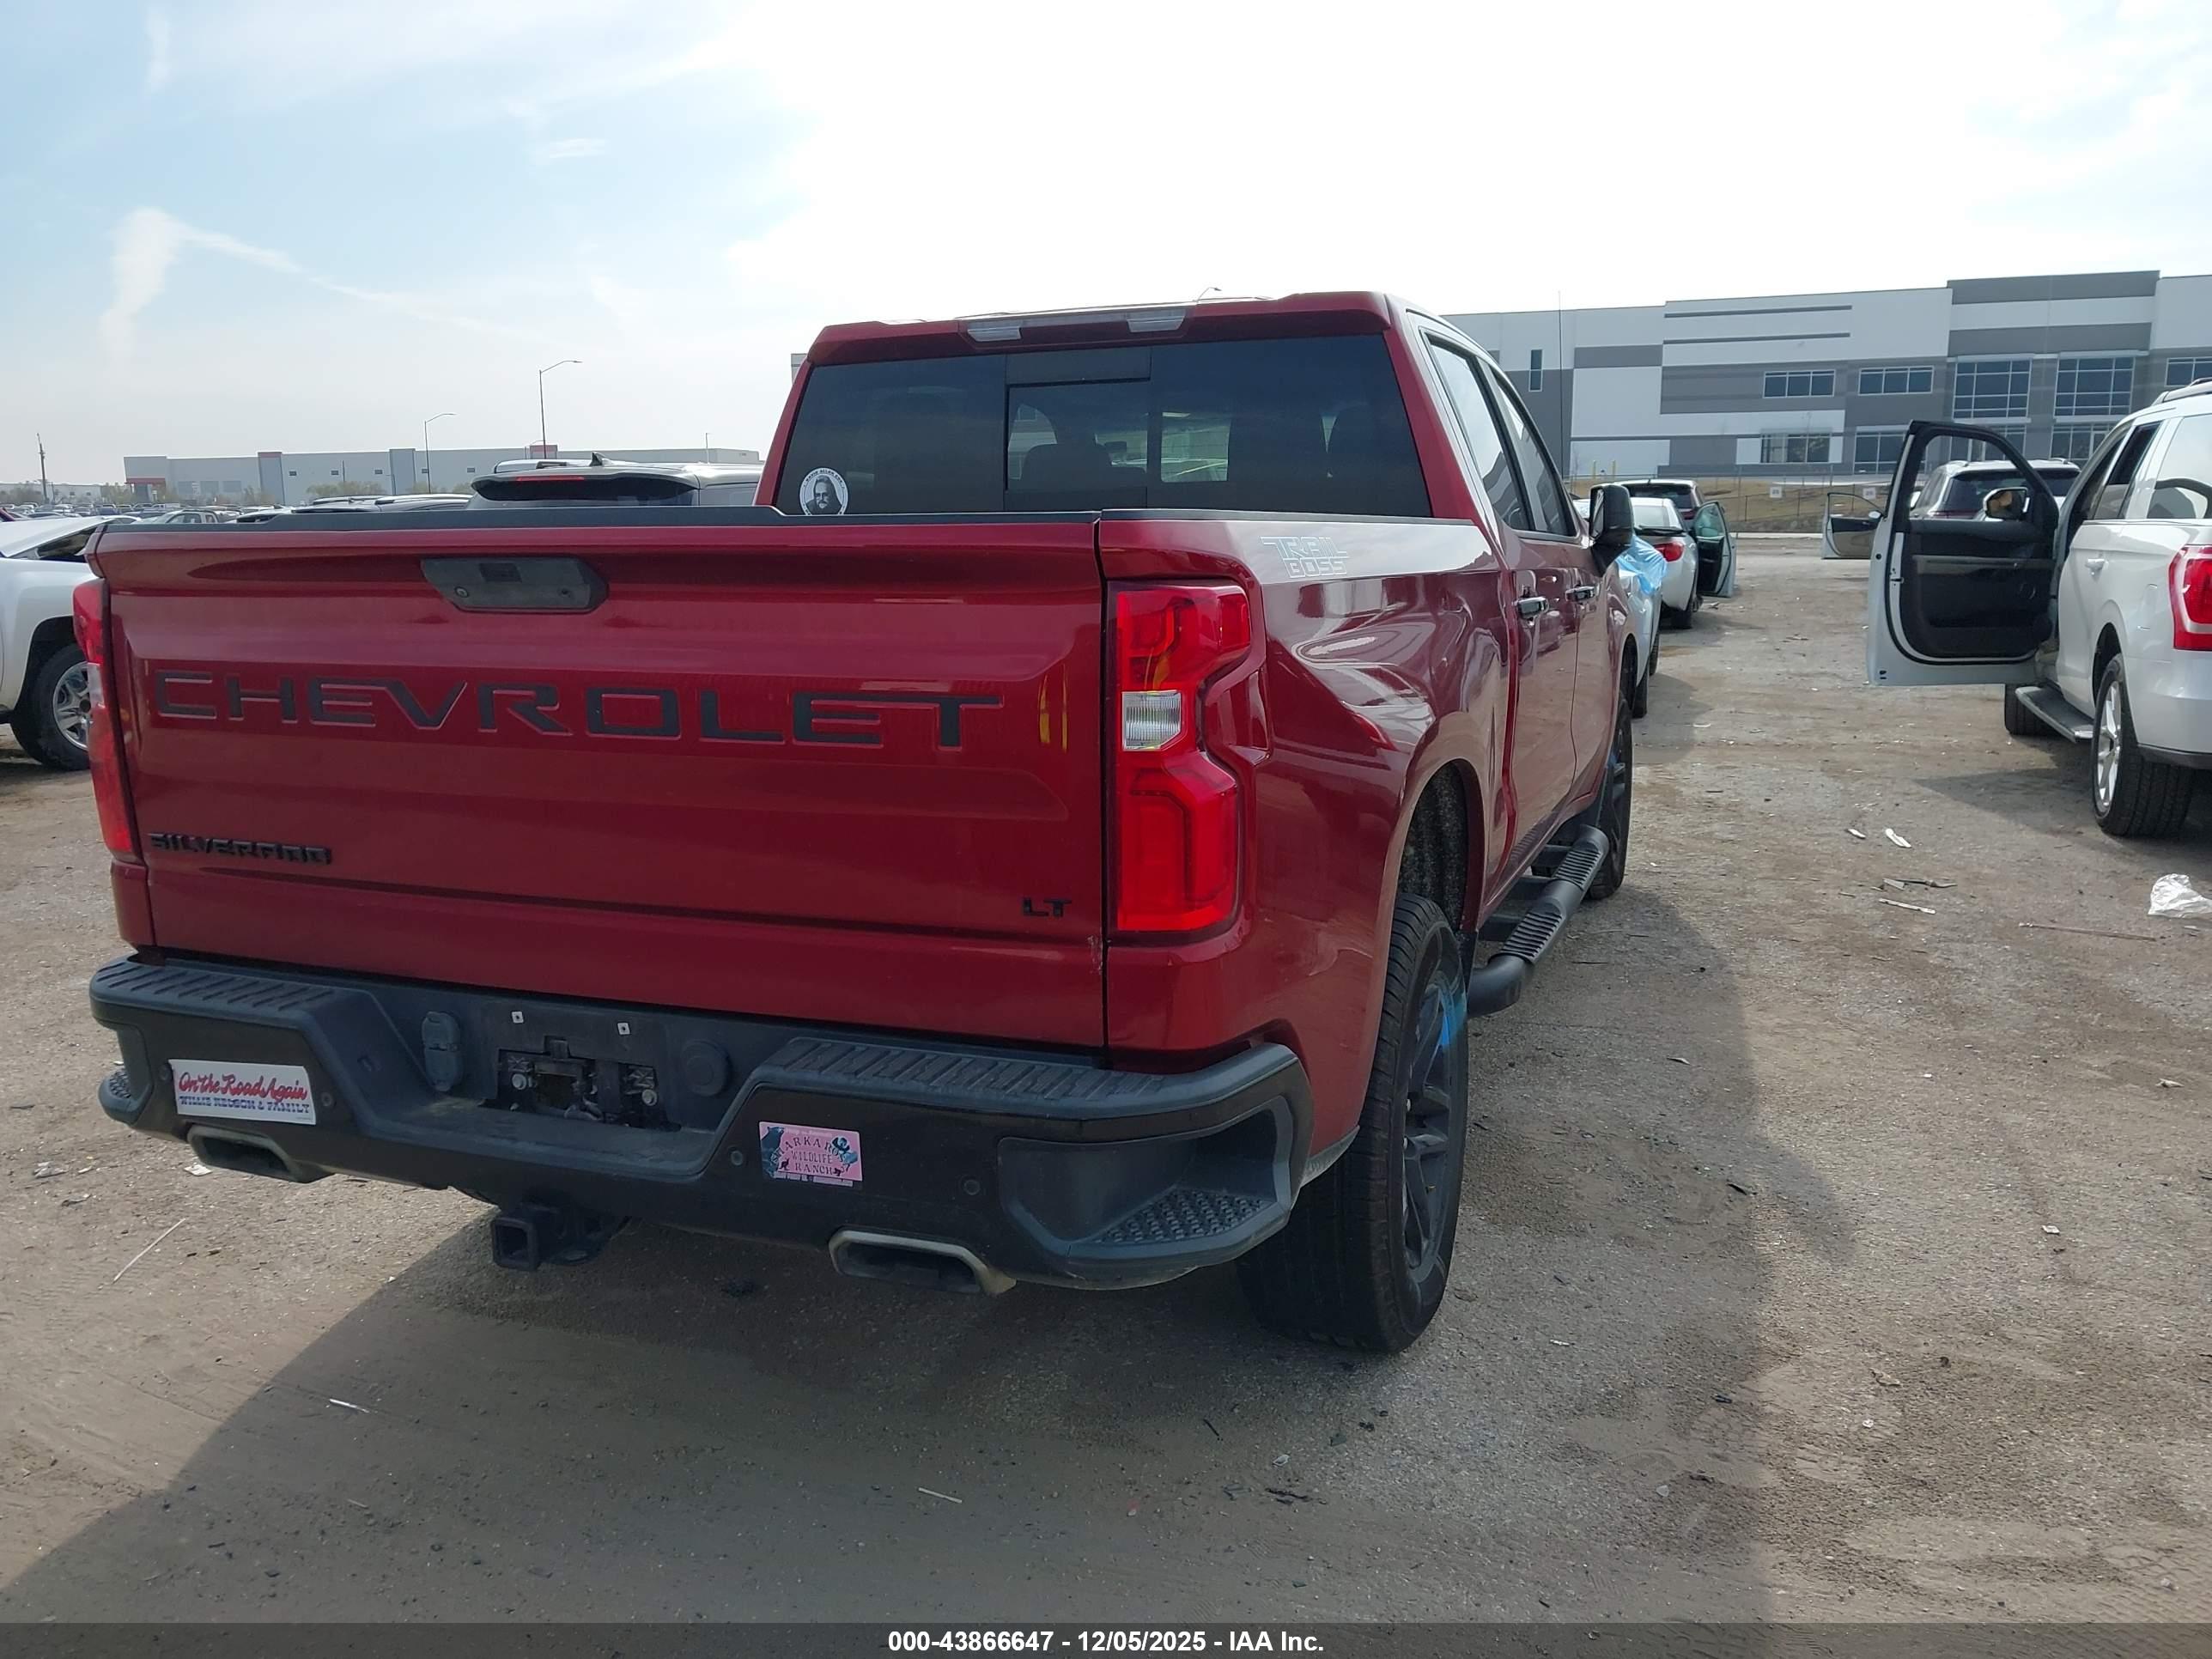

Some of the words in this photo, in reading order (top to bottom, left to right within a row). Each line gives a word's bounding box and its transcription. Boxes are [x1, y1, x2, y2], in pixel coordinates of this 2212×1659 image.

[1260, 536, 1349, 559] TRAIL
[1282, 557, 1347, 579] BOSS
[155, 671, 1004, 752] CHEVROLET
[148, 831, 332, 866] SILVERADO
[1022, 896, 1072, 918] LT
[179, 1072, 198, 1092] On
[221, 1073, 266, 1098] Road
[265, 1077, 307, 1103] Again
[791, 1150, 833, 1164] WILDLIFE
[795, 1163, 833, 1176] RANCH
